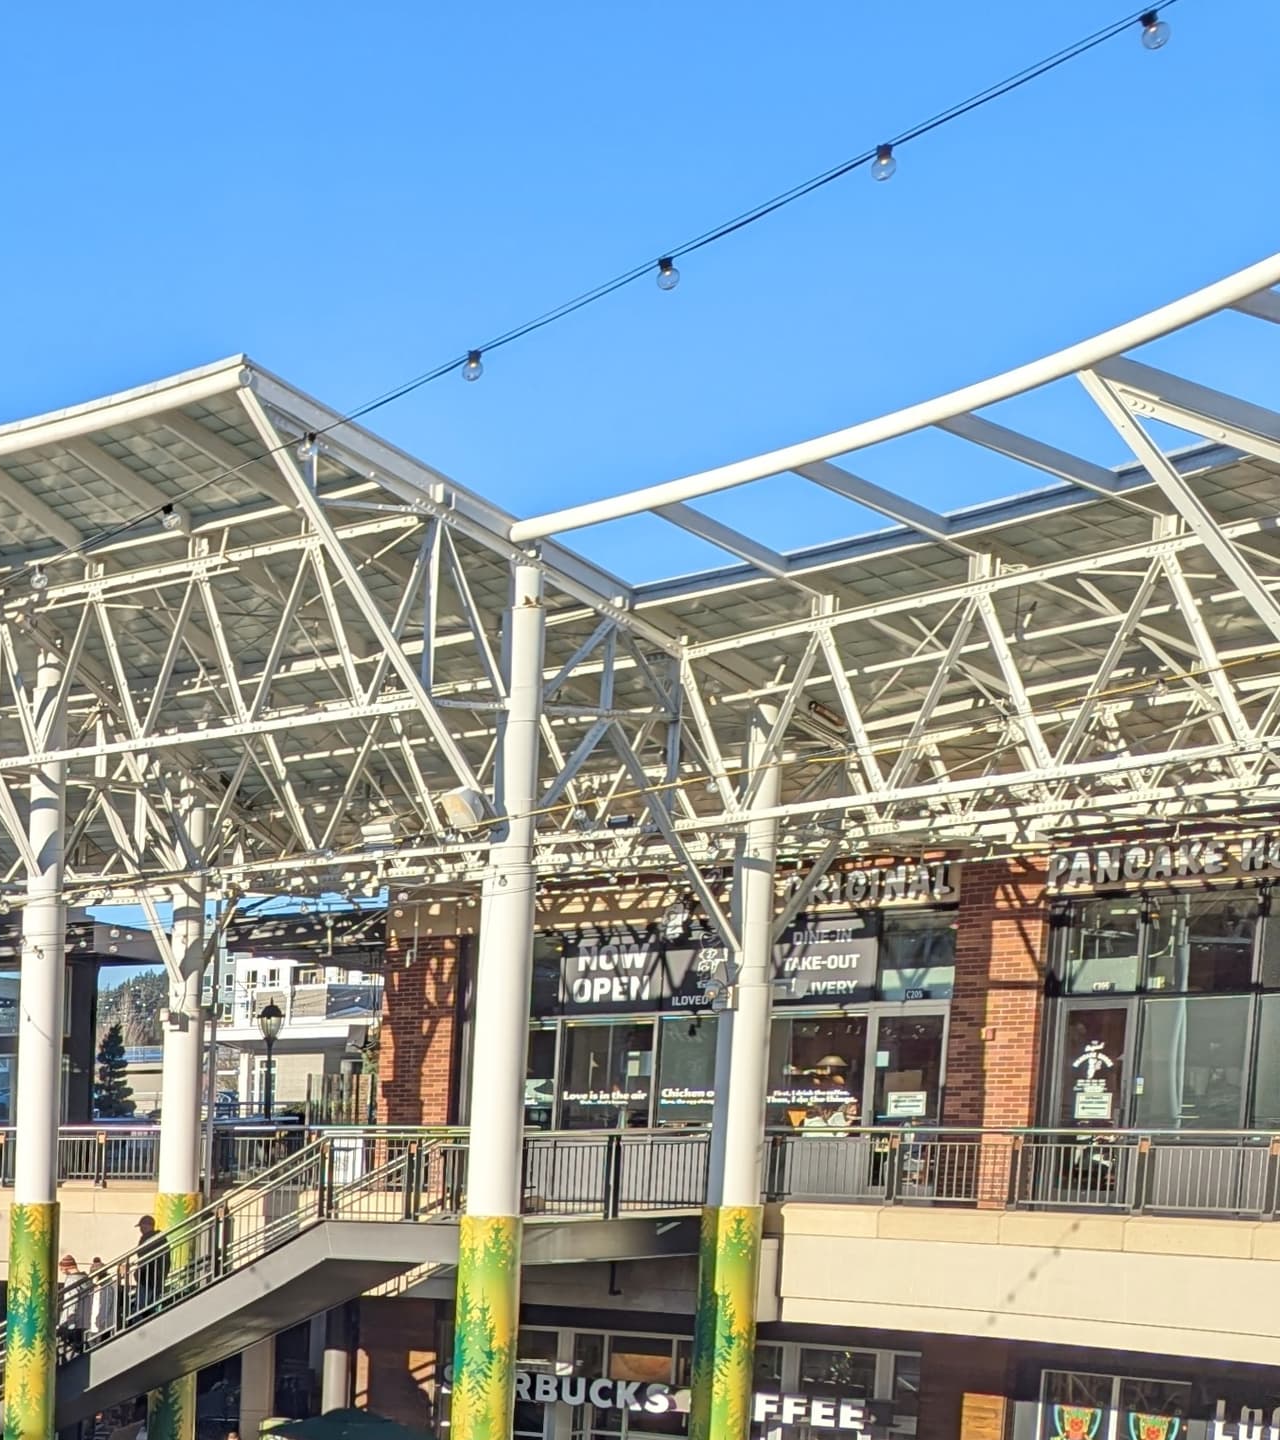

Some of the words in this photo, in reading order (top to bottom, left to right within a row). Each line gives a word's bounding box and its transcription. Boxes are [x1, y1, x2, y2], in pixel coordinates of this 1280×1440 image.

[1047, 841, 1225, 889] PANCAKE
[783, 864, 951, 904] ORIGINAL
[793, 928, 853, 945] DINE-IN
[578, 944, 650, 971] NOW
[783, 954, 860, 971] TAKE-OUT
[573, 976, 650, 1003] OPEN
[563, 1090, 588, 1100] Love
[611, 1090, 630, 1100] the
[630, 1091, 648, 1100] air
[661, 1087, 705, 1098] Chicken
[754, 1392, 866, 1429] FFEE
